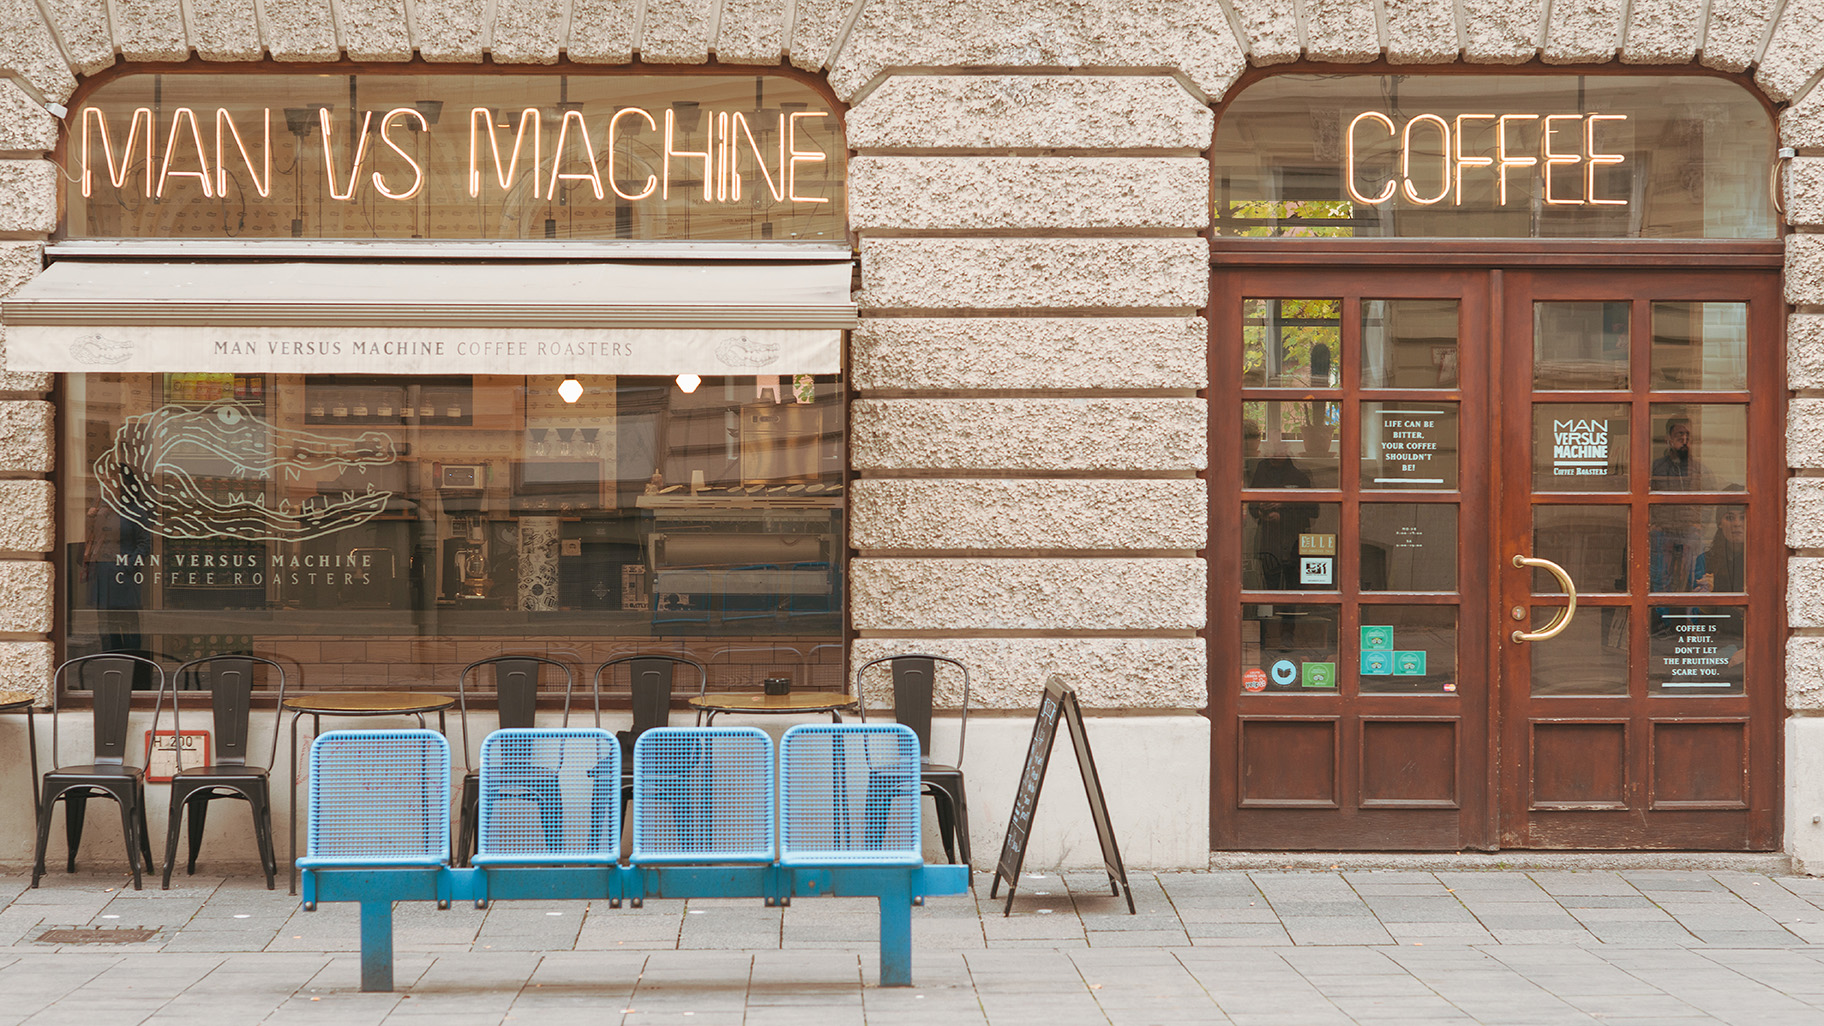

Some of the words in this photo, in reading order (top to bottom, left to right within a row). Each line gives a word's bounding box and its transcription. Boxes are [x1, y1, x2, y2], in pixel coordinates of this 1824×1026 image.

[80, 106, 270, 198] MAN
[319, 107, 427, 201] VS
[468, 106, 830, 204] MACHINE
[1347, 110, 1629, 207] COFFEE
[214, 341, 257, 355] MAN
[268, 341, 341, 356] VERSUS
[352, 341, 445, 356] MACHINE
[457, 341, 527, 356] COFFEE
[537, 342, 633, 357] ROASTERS
[1384, 420, 1402, 428] LIFE
[1404, 420, 1421, 428] CAN
[1423, 420, 1434, 428] BE
[1553, 419, 1608, 432] MAN
[1553, 432, 1608, 445] VERSUS
[1381, 442, 1404, 450] YOUR
[1406, 442, 1437, 450] COFFEE
[1385, 453, 1433, 461] SHOULDN'T
[1553, 445, 1608, 459] MACHINE
[231, 465, 301, 481] MAN
[1402, 464, 1416, 472] BE!
[115, 554, 161, 567] MAN
[176, 554, 257, 567] VERSUS
[271, 554, 372, 567] MACHINE
[115, 572, 215, 585] COFFEE
[234, 572, 371, 585] ROASTERS
[1675, 624, 1706, 632] COFFEE
[1708, 624, 1717, 632] IS
[1678, 635, 1685, 643] A
[1687, 635, 1714, 643] FRUIT.
[1674, 646, 1700, 654] DON'T
[1703, 646, 1718, 654] LET
[1663, 657, 1680, 665] THE
[1682, 657, 1729, 665] FRUITINESS
[1671, 668, 1698, 676] SCARE
[1700, 668, 1720, 676] YOU.
